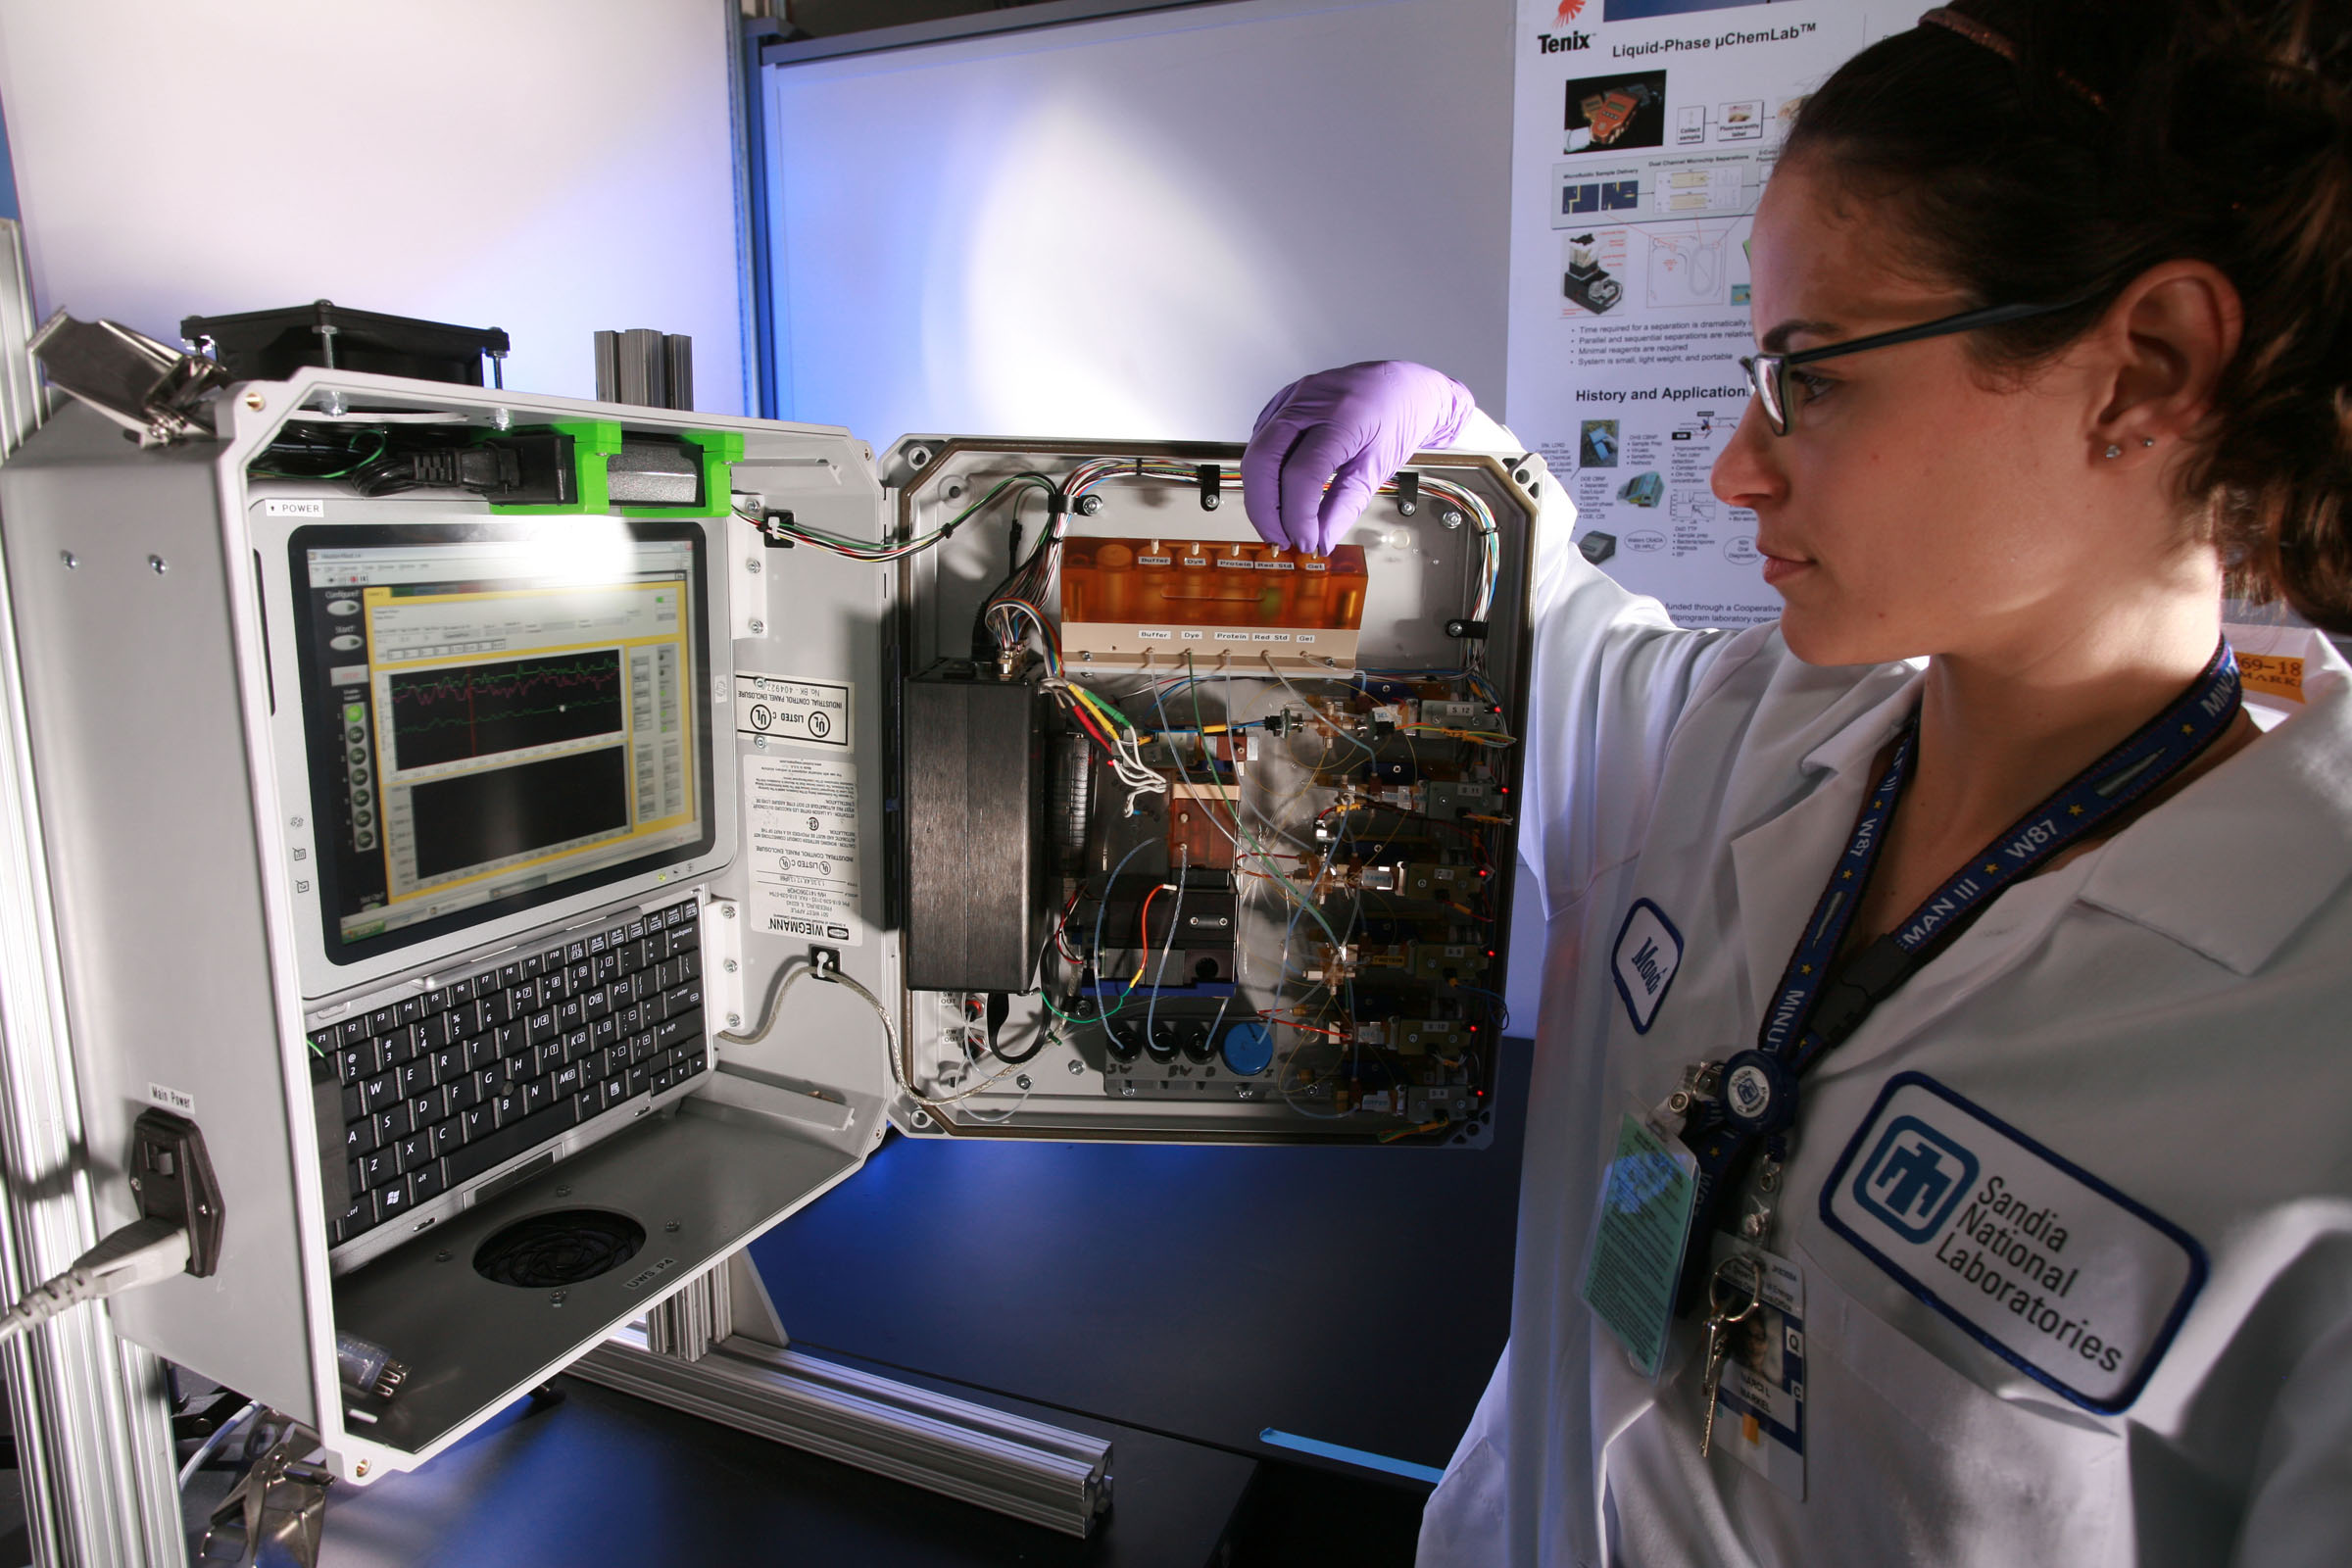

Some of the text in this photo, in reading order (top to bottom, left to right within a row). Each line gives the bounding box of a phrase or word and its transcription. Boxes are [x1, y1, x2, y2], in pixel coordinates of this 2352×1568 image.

[1538, 31, 1591, 54] Tenix
[1612, 37, 1711, 58] Liquid-Phase
[1650, 322, 1690, 331] separation
[1576, 390, 1627, 403] History
[1631, 388, 1657, 400] and
[282, 504, 319, 513] POWER
[1734, 604, 1782, 612] Cooperative
[1712, 614, 1751, 623] laboratory
[2235, 658, 2302, 676] 69-18
[738, 691, 767, 700] ENCLOSURE
[786, 696, 809, 705] CONTROL
[810, 700, 842, 709] INDUSTRIAL
[781, 713, 804, 723] LISTED
[1850, 817, 1878, 858] W87
[2006, 819, 2058, 859] W87
[756, 846, 784, 855] ENCLOSURE
[1902, 878, 1981, 945] MAN III
[672, 927, 692, 939] backspace
[769, 918, 823, 937] WIEGMANN
[550, 951, 560, 959] F10
[614, 986, 619, 996] P
[589, 997, 595, 1005] O
[533, 1017, 540, 1028] U
[504, 1030, 511, 1041] Y
[598, 1025, 602, 1035] L
[571, 1036, 576, 1047] K
[472, 1043, 478, 1054] T
[544, 1048, 548, 1058] J
[441, 1055, 448, 1066] R
[514, 1059, 522, 1070] H
[407, 1068, 414, 1081] E
[485, 1072, 492, 1084] G
[560, 1072, 568, 1084] M
[370, 1081, 382, 1096] W
[453, 1087, 459, 1099] F
[532, 1085, 539, 1097] N
[152, 1086, 190, 1108] Main Power
[419, 1101, 427, 1112] D
[503, 1100, 510, 1110] B
[384, 1115, 391, 1128] S
[471, 1112, 478, 1124] V
[348, 1131, 357, 1144] A
[439, 1128, 446, 1139] C
[407, 1142, 415, 1155] X
[370, 1159, 378, 1171] Z
[418, 1173, 427, 1183] alt
[1977, 1175, 2070, 1253] Sandia
[1956, 1202, 2081, 1298] National
[1934, 1231, 2124, 1373] Laboratories
[1789, 1334, 1798, 1351] Q
